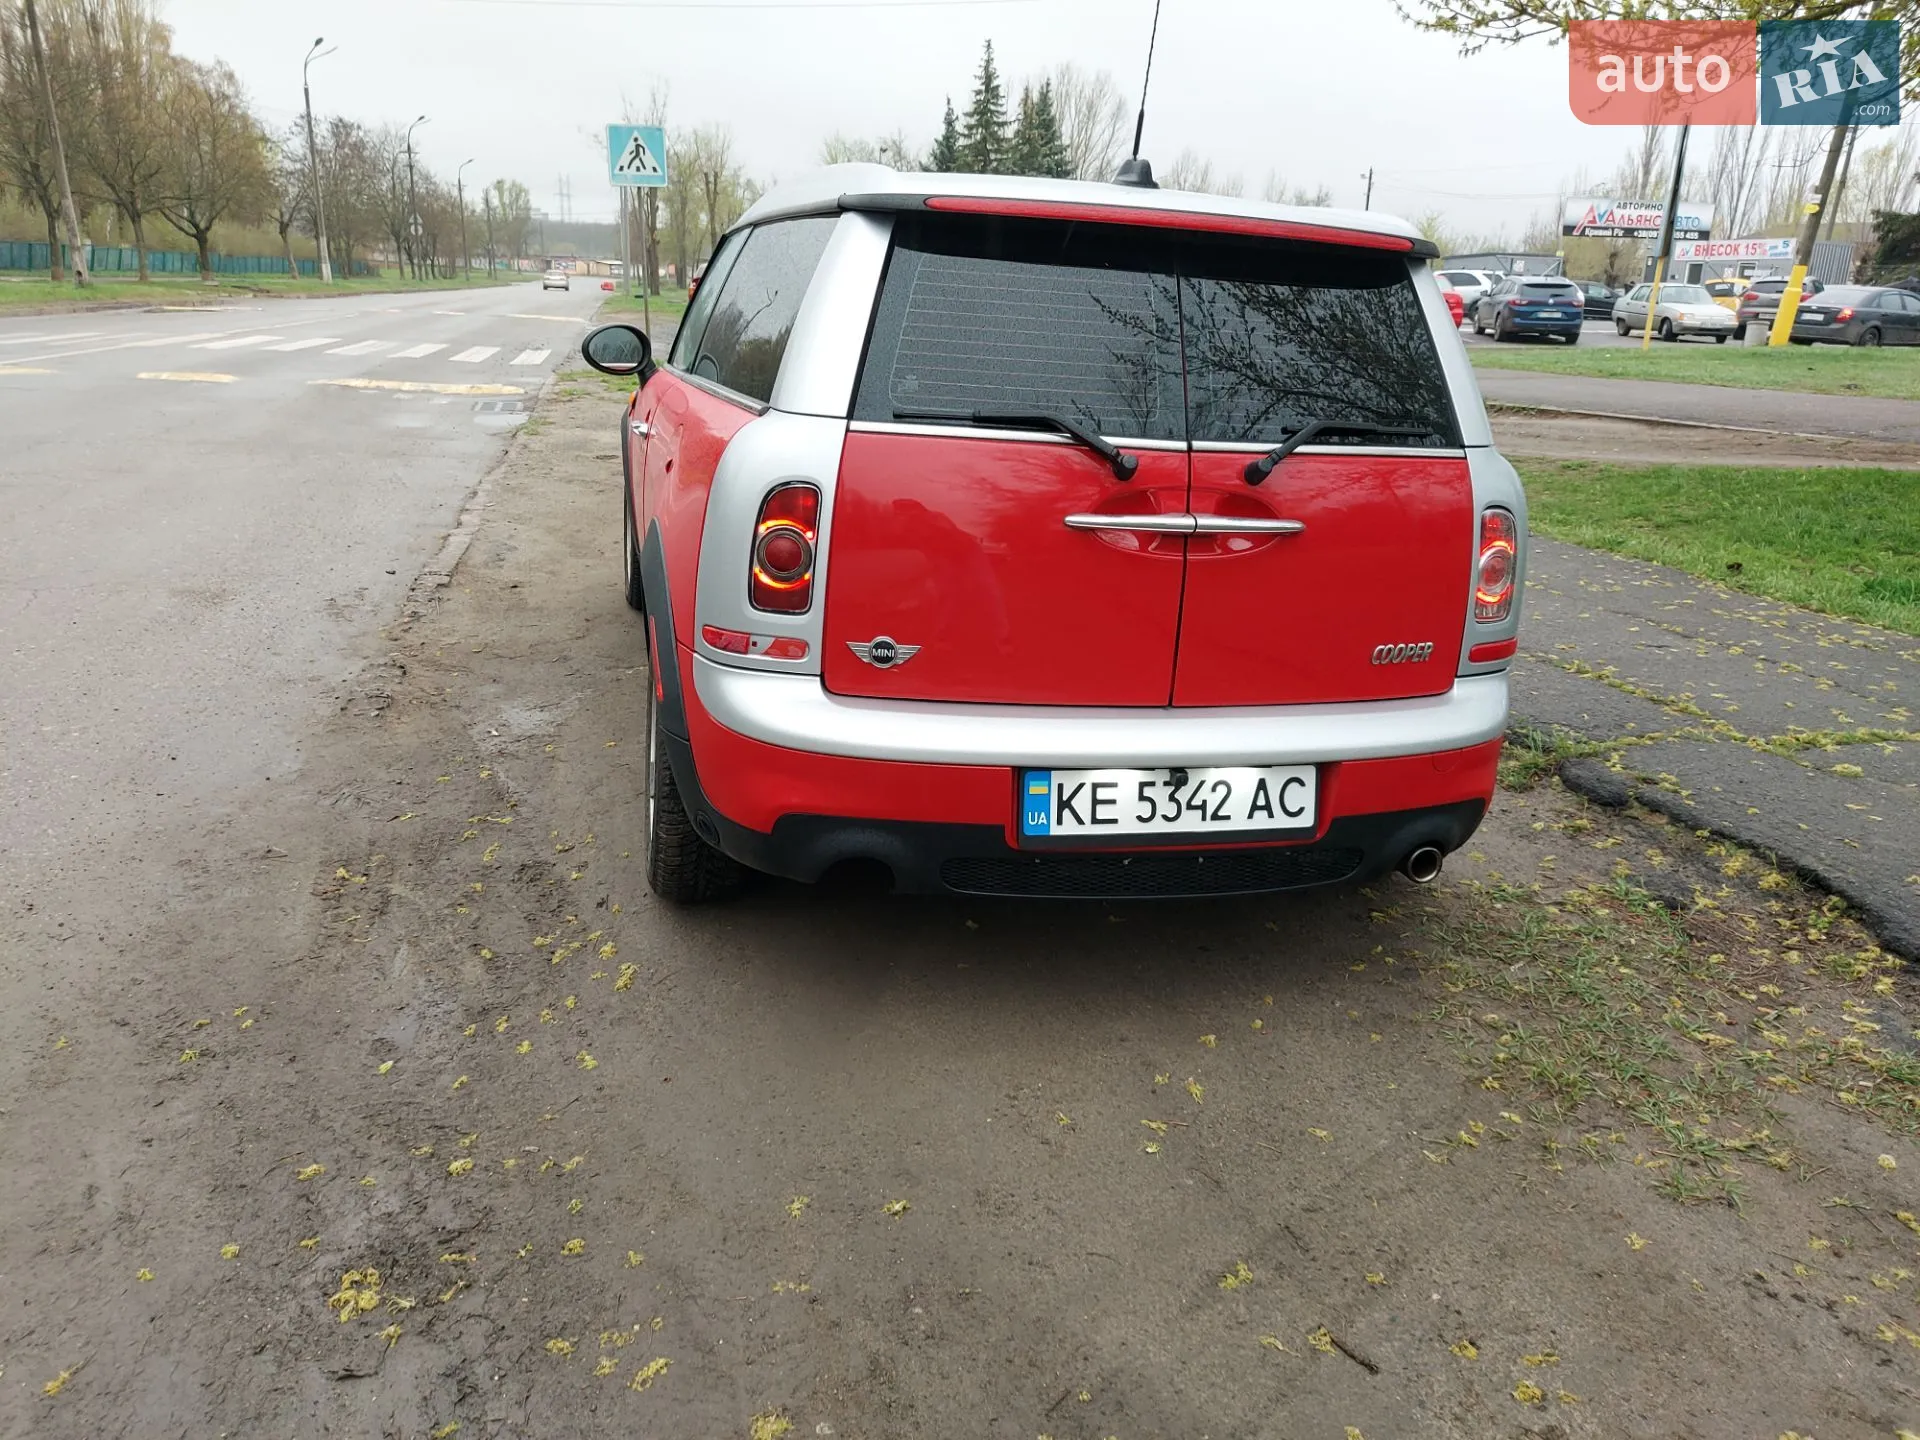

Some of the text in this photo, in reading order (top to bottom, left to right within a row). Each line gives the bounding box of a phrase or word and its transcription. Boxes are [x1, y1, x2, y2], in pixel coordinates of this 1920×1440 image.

[1675, 215, 1700, 229] ВТО
[1694, 243, 1740, 256] ВНЕСОК
[872, 648, 895, 657] MINI
[1371, 641, 1434, 665] COOPER
[1056, 776, 1306, 826] KE 5342 AC
[1028, 811, 1048, 825] UA
